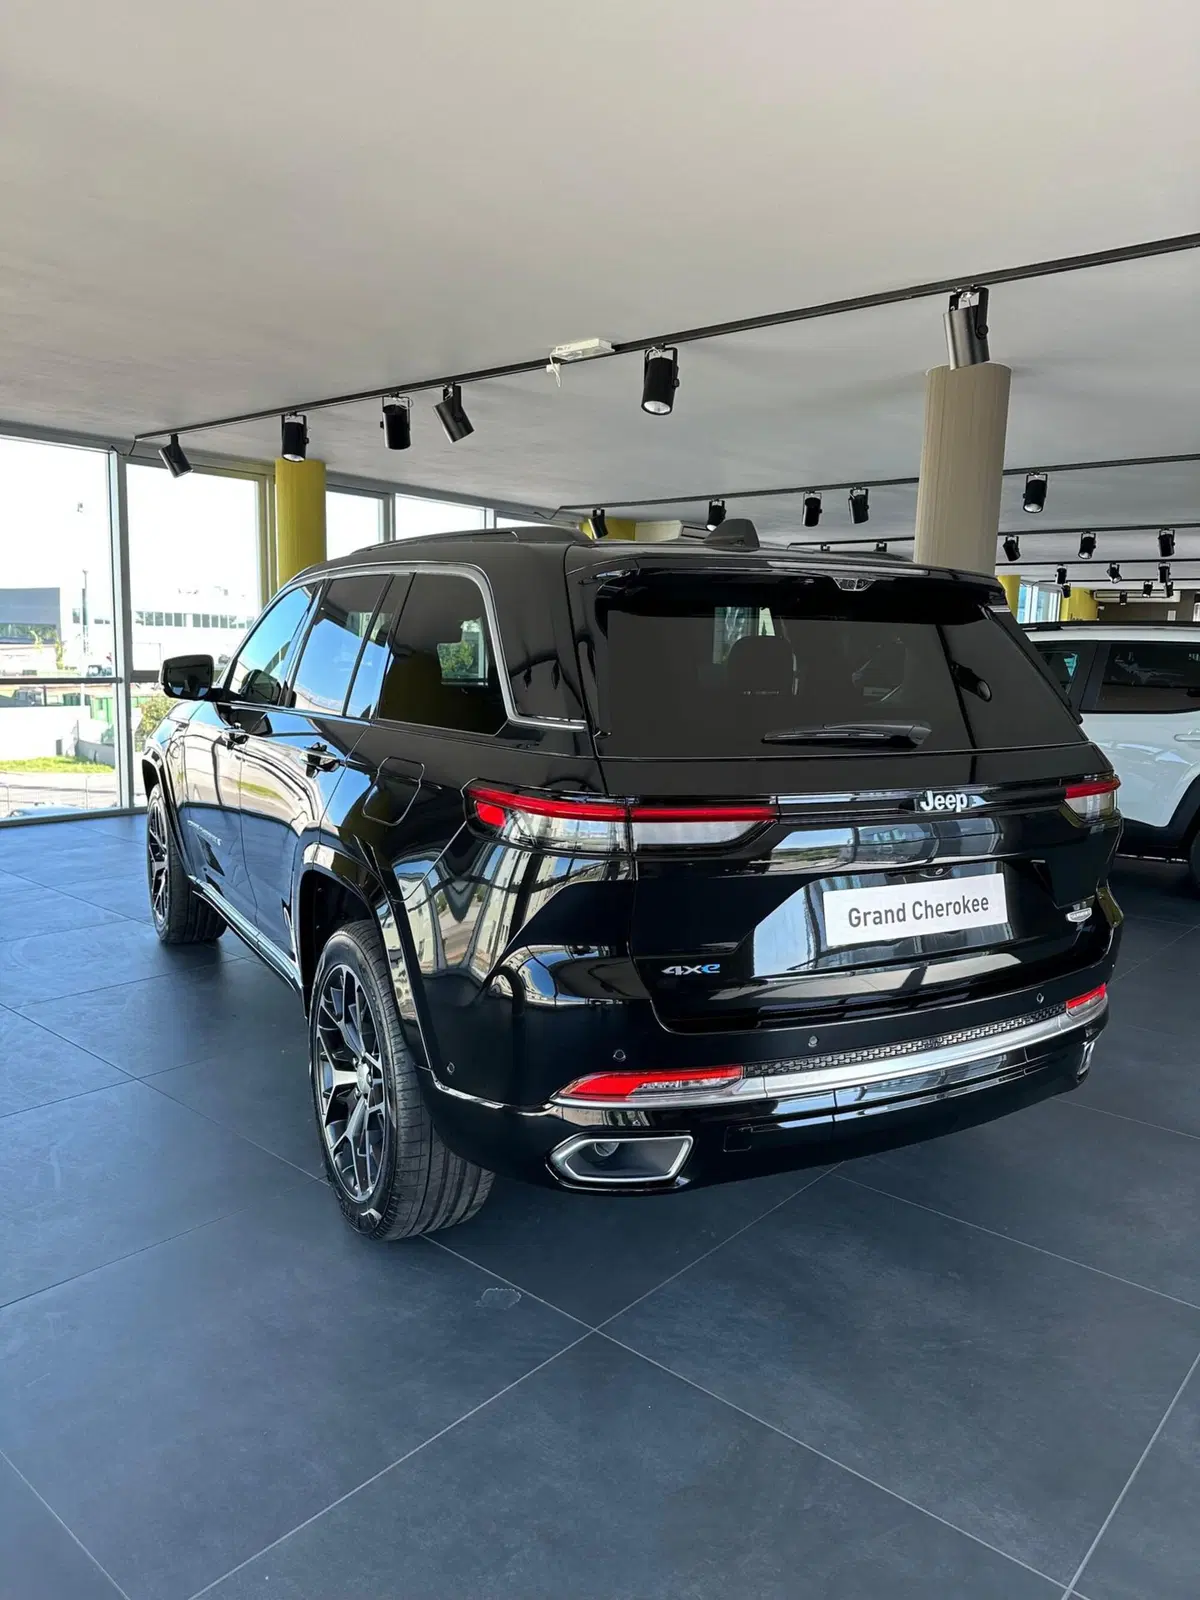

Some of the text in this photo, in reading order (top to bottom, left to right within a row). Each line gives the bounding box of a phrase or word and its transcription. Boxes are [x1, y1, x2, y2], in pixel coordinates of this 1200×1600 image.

[919, 790, 968, 813] Jeep
[848, 895, 990, 928] Grand Cherokee
